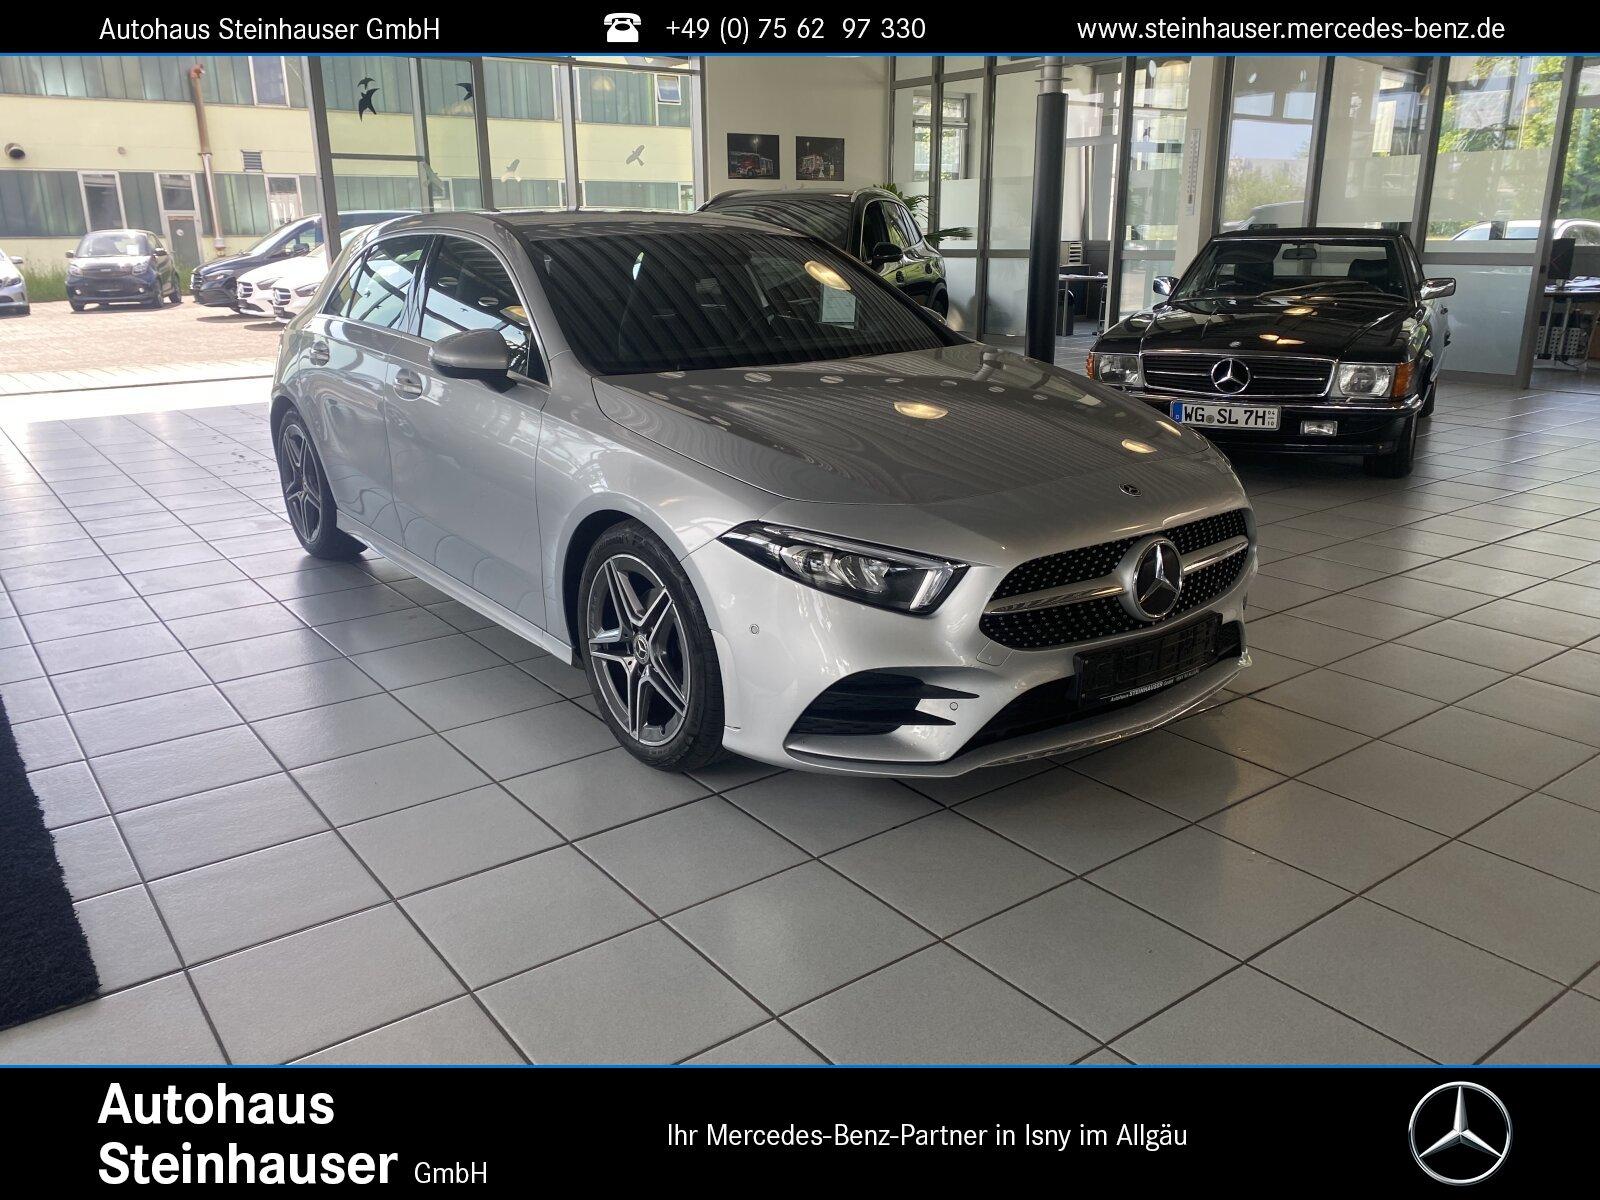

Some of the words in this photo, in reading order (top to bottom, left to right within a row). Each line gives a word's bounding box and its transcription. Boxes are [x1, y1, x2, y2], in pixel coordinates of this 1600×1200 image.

[1184, 406, 1205, 423] WG
[1217, 408, 1239, 425] SL
[1243, 409, 1266, 426] 7H
[1129, 680, 1163, 697] STEINHAUSER
